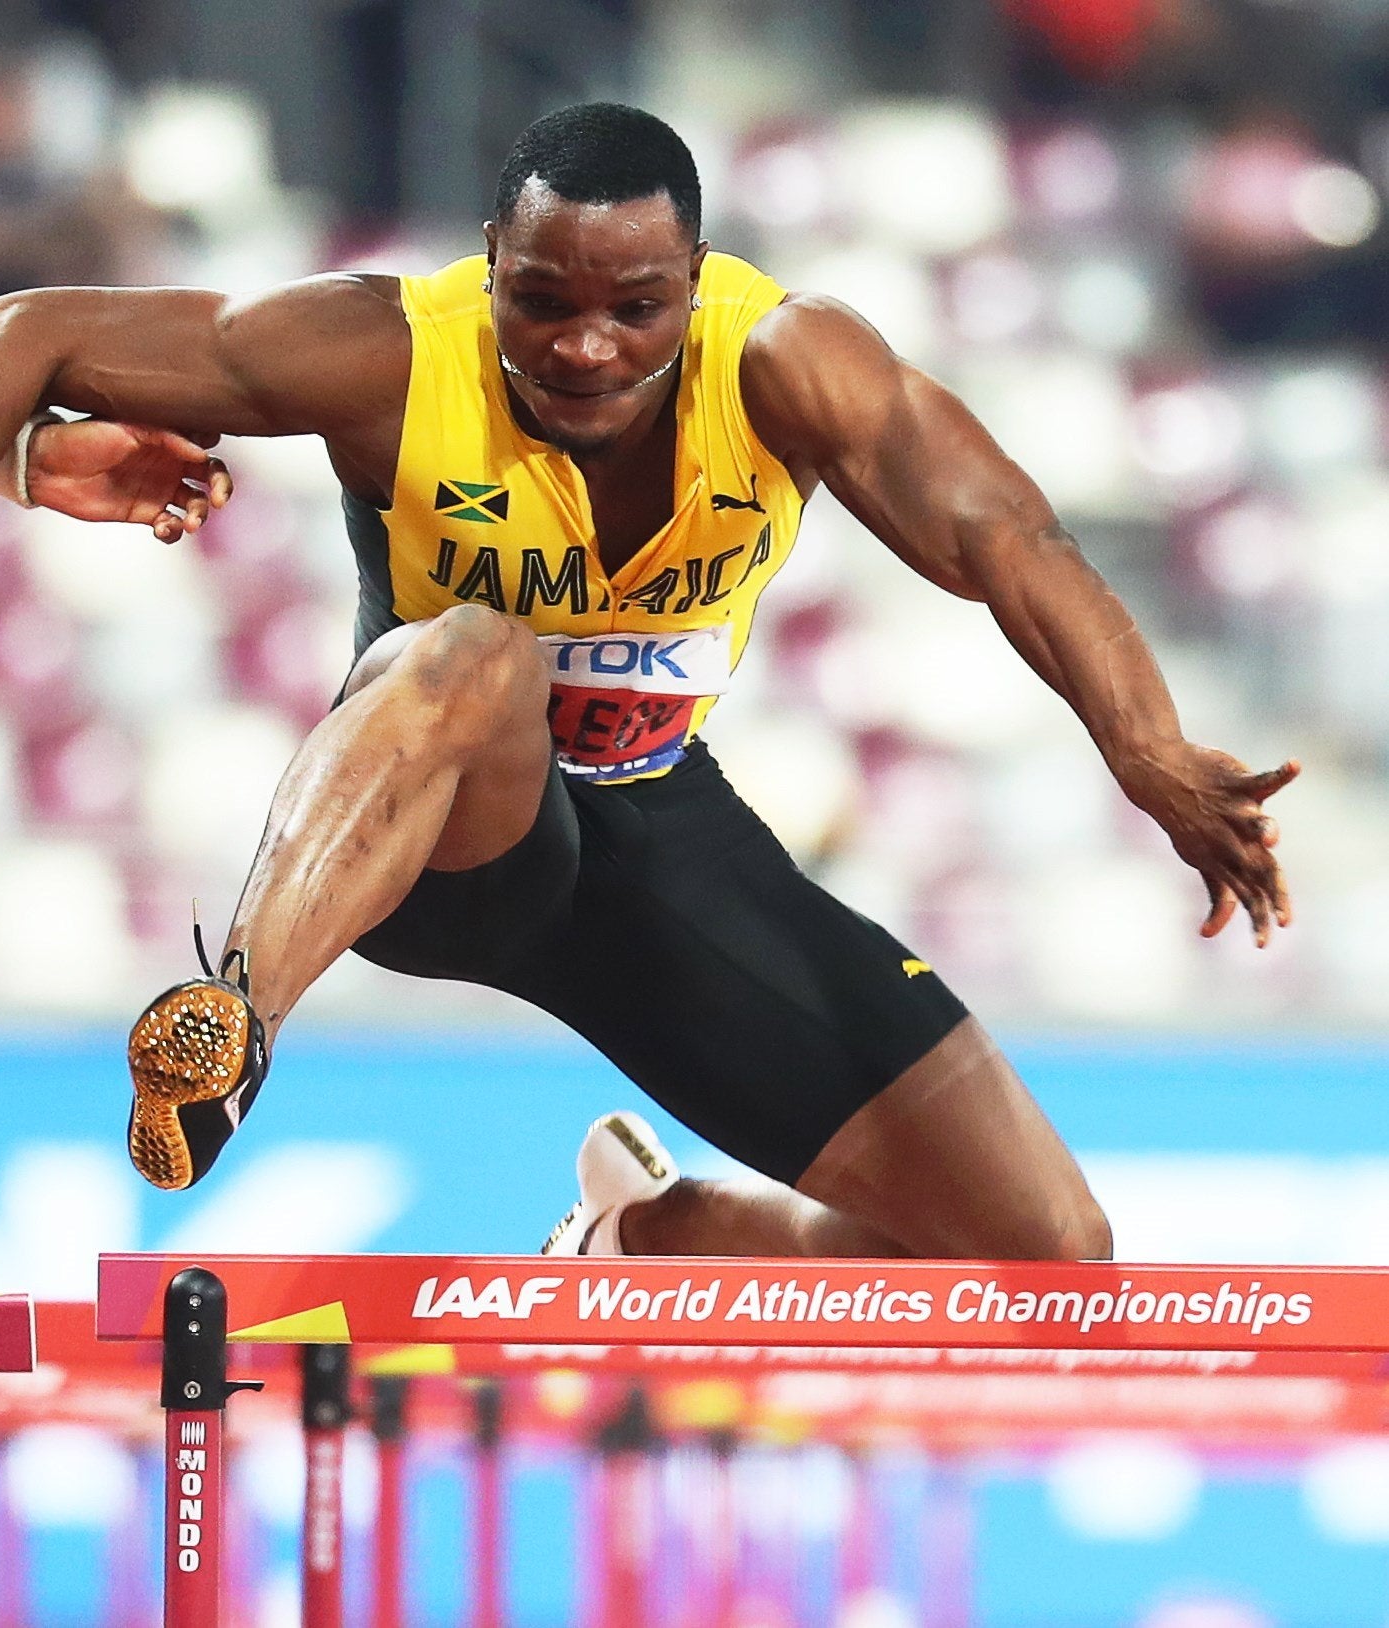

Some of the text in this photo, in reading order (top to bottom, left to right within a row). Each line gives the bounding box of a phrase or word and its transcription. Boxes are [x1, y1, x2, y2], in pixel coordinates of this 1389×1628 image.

[549, 638, 690, 680] TDK
[412, 1277, 1313, 1335] IAAF World Athletics Championships
[176, 1449, 206, 1573] MONDO
